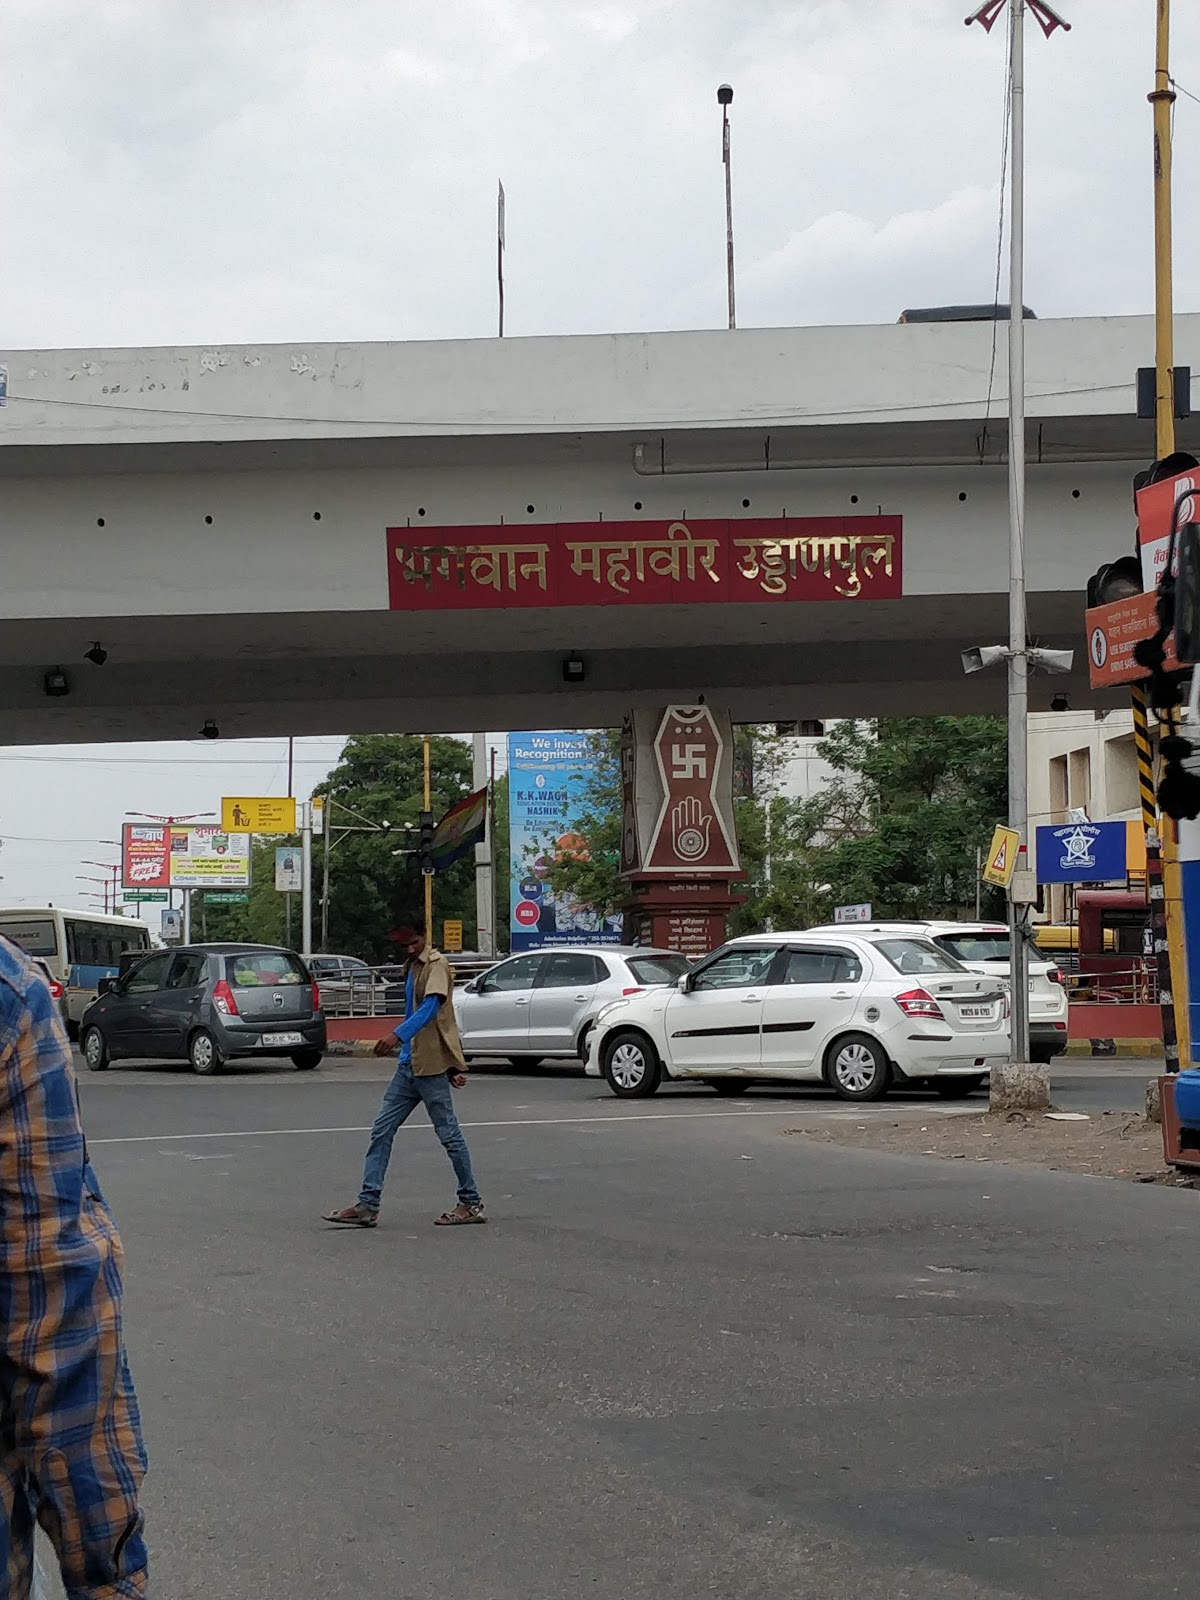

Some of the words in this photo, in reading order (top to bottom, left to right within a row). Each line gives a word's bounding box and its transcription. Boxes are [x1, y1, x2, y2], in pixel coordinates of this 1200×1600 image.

[396, 542, 550, 592] भगवान
[566, 523, 720, 594] महावीर
[733, 535, 896, 598] उड्डाणपुल
[532, 738, 551, 749] We
[515, 748, 582, 761] Recognition
[527, 807, 558, 815] NASHIK
[133, 866, 157, 877] FREE
